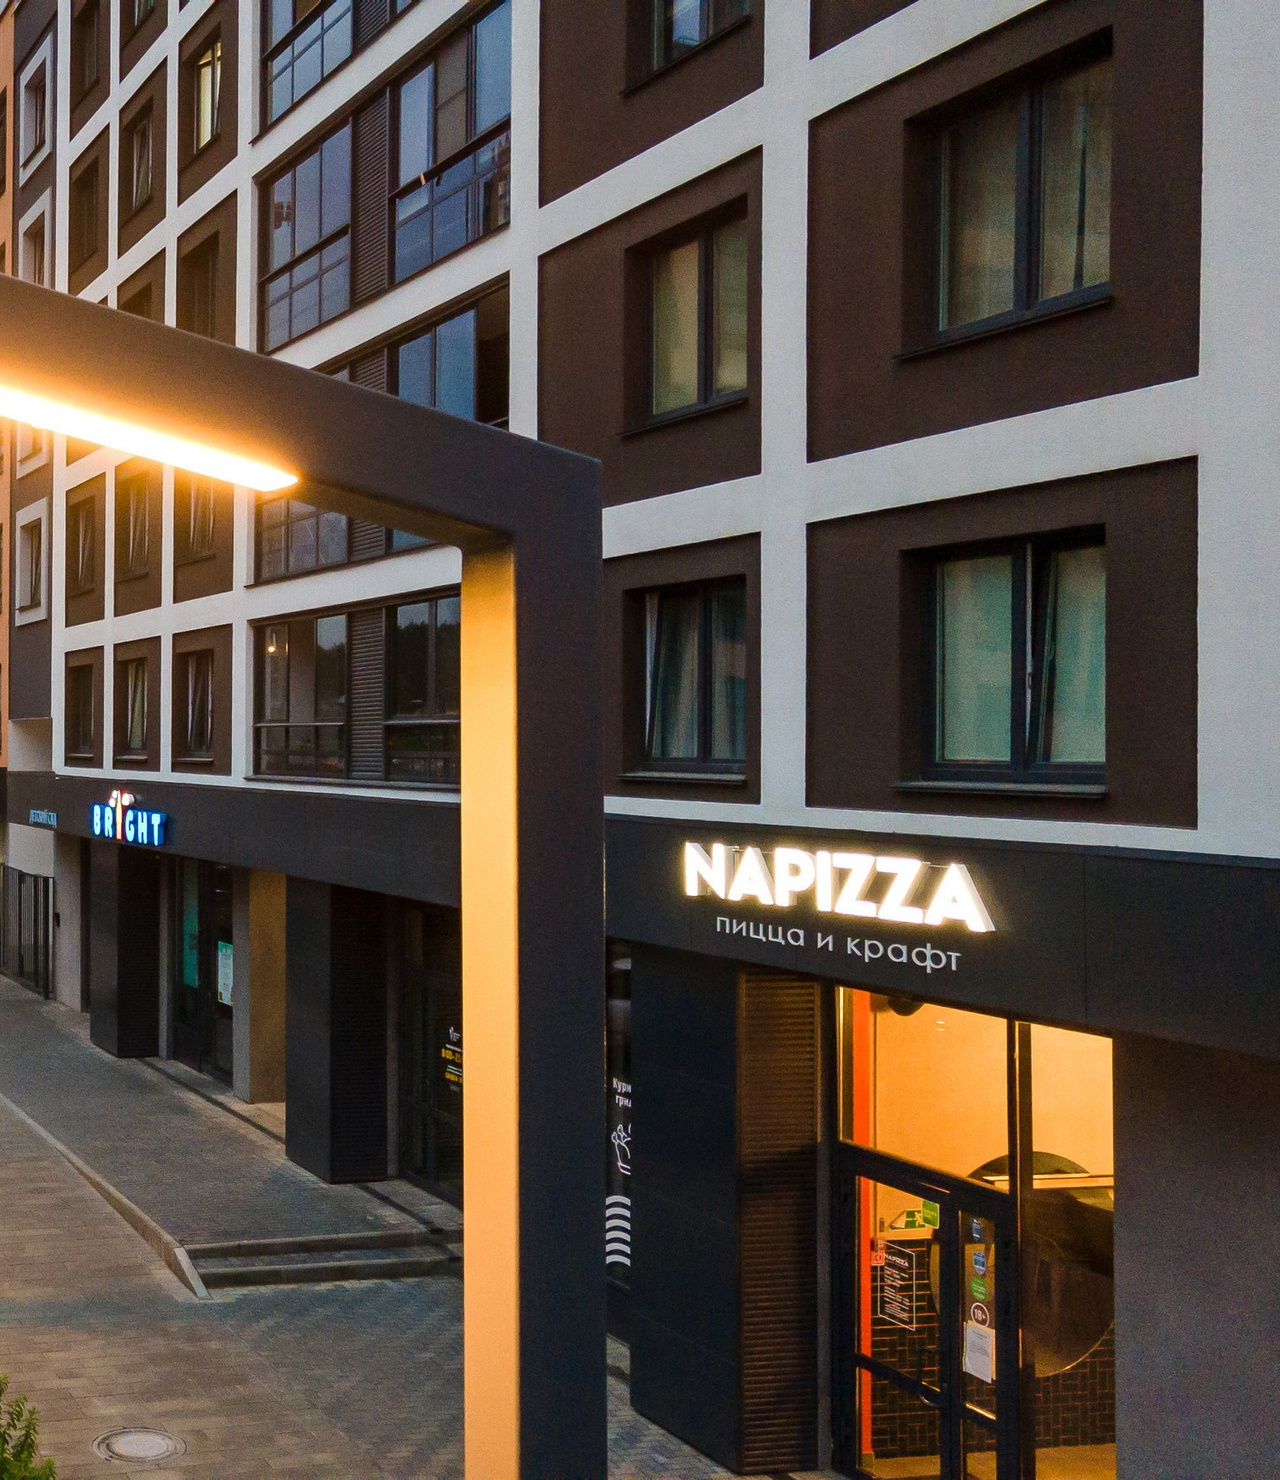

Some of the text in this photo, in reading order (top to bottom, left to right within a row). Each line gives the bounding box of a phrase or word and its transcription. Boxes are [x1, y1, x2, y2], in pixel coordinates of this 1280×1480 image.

[91, 791, 164, 846] BRIGHT
[685, 842, 995, 932] NAPIZZA
[716, 916, 961, 973] пицца и крафт
[974, 1308, 986, 1321] 18+
